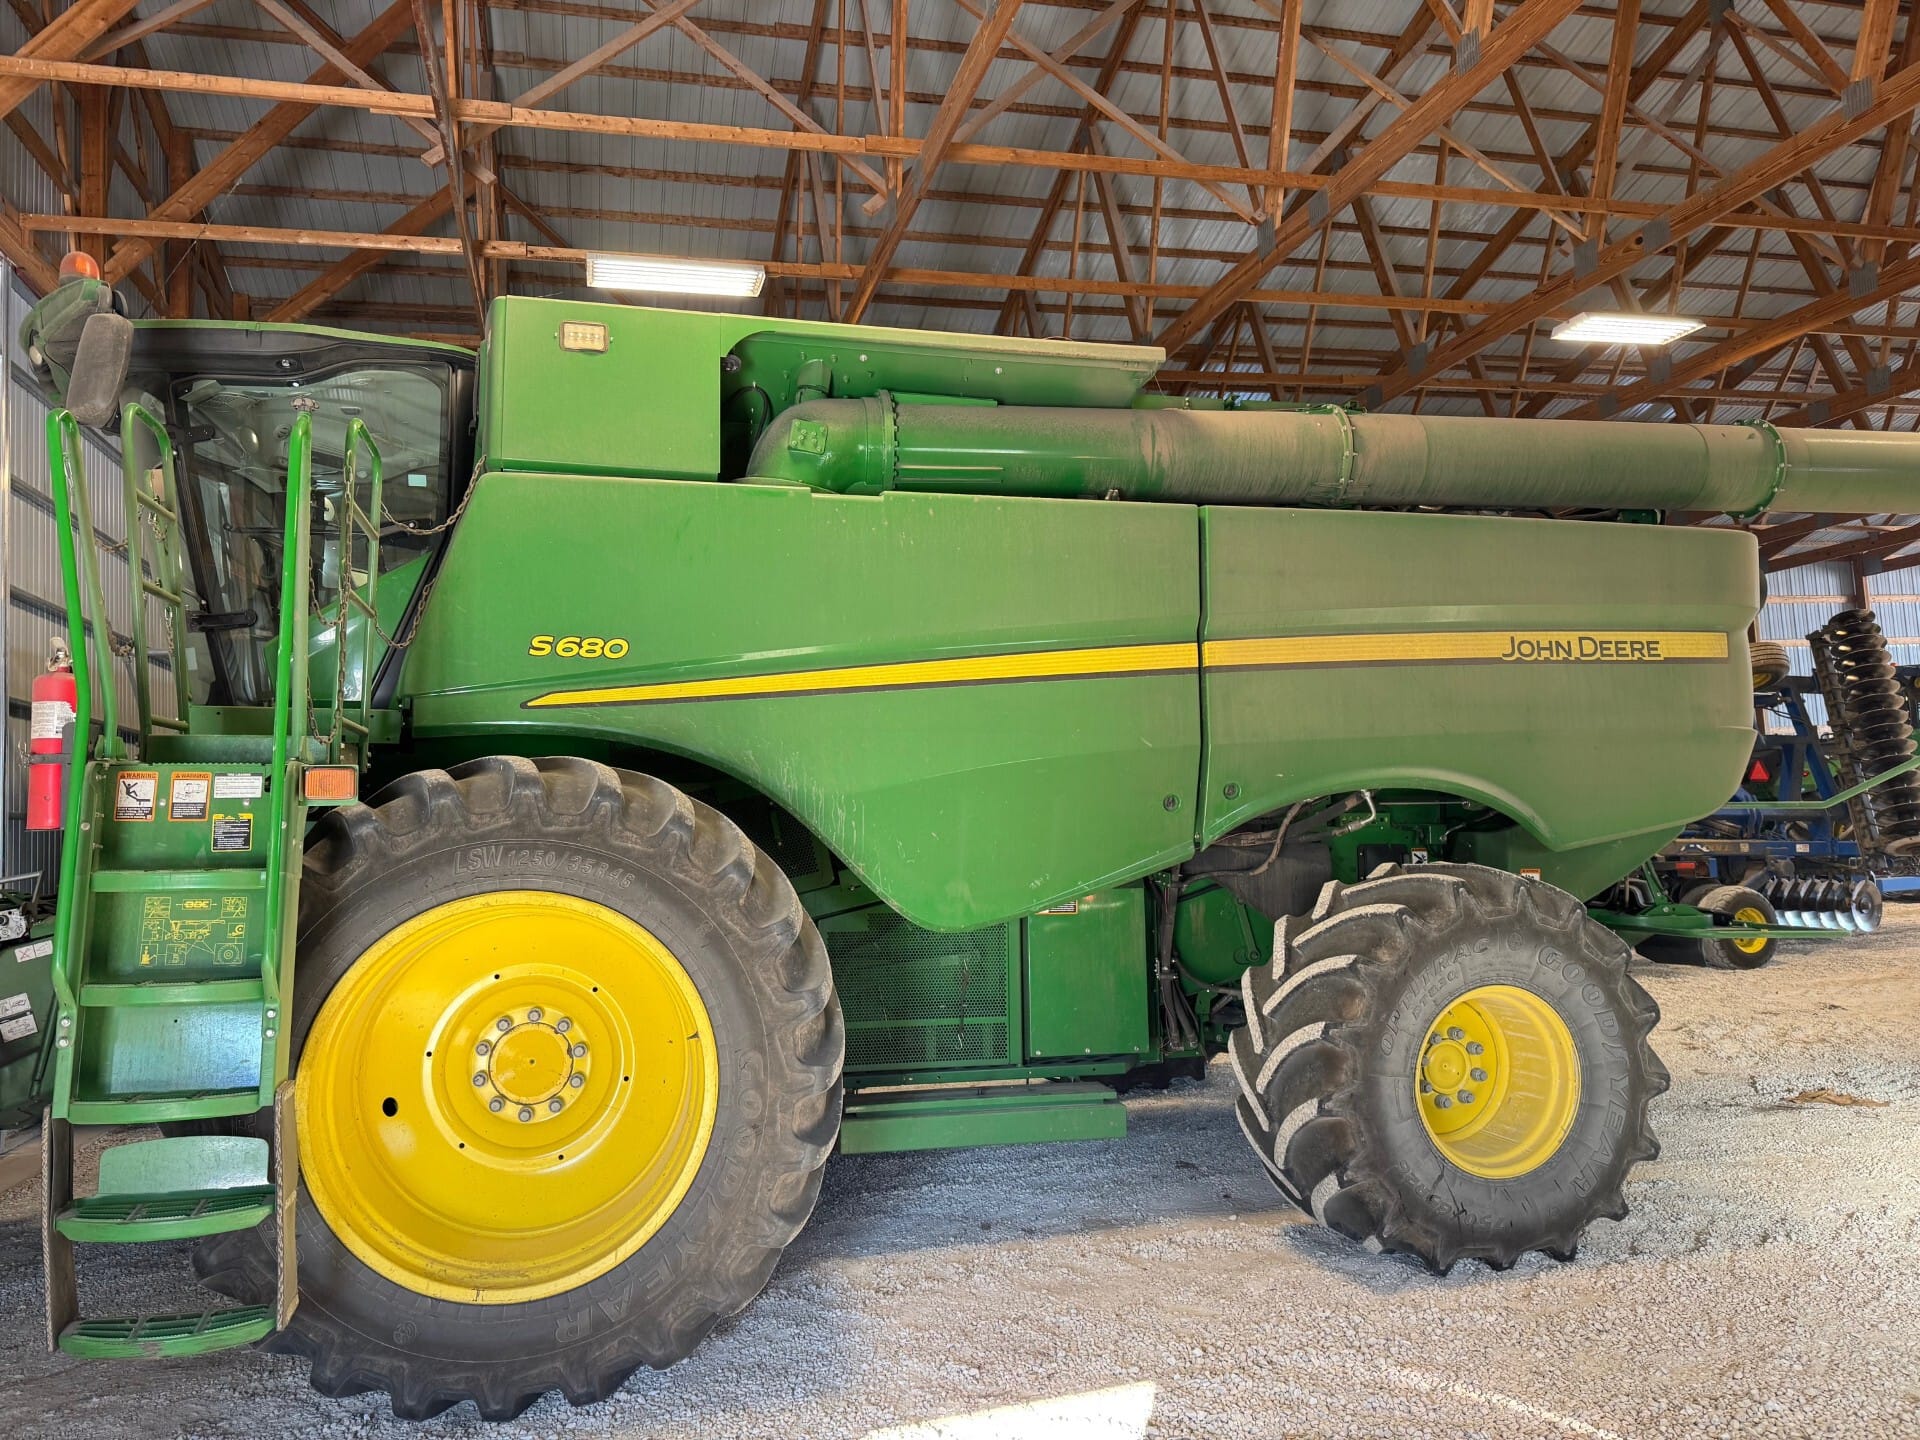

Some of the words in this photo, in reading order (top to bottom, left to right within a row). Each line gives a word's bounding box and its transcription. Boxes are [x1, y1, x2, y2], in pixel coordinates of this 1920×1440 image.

[528, 634, 629, 659] S680
[1501, 635, 1572, 659] JOHN
[1577, 635, 1662, 659] DEERE
[452, 846, 504, 876] LSW
[1381, 937, 1489, 1056] OPTITRAC
[1537, 945, 1631, 1198] GOODYEAR
